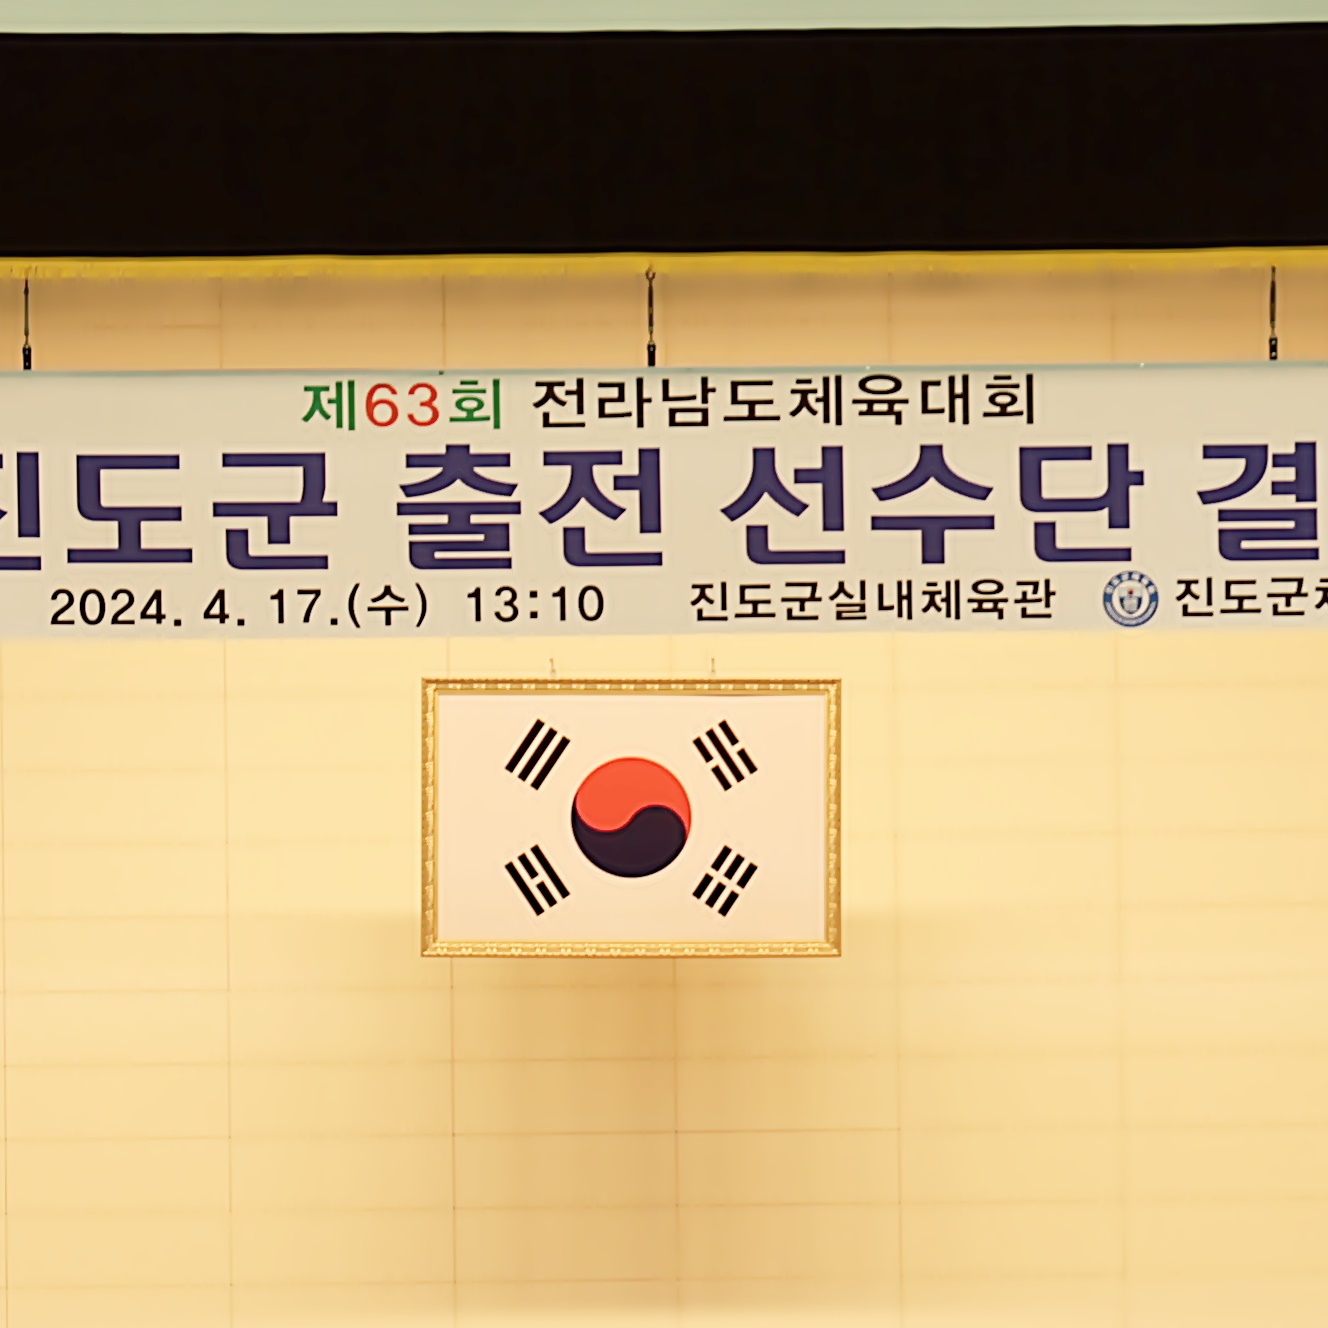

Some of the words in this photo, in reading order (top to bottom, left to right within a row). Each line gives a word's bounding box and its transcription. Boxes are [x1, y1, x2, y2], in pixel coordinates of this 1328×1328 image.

[302, 379, 502, 431] 제63회
[532, 374, 1036, 429] 전라남도체육대회
[396, 443, 664, 570] 출전
[720, 443, 1145, 565] 선수단
[50, 588, 183, 628] 2024.
[203, 588, 246, 627] 4.
[466, 584, 605, 624] 13:10
[689, 578, 1057, 622] 진도군실내체육관
